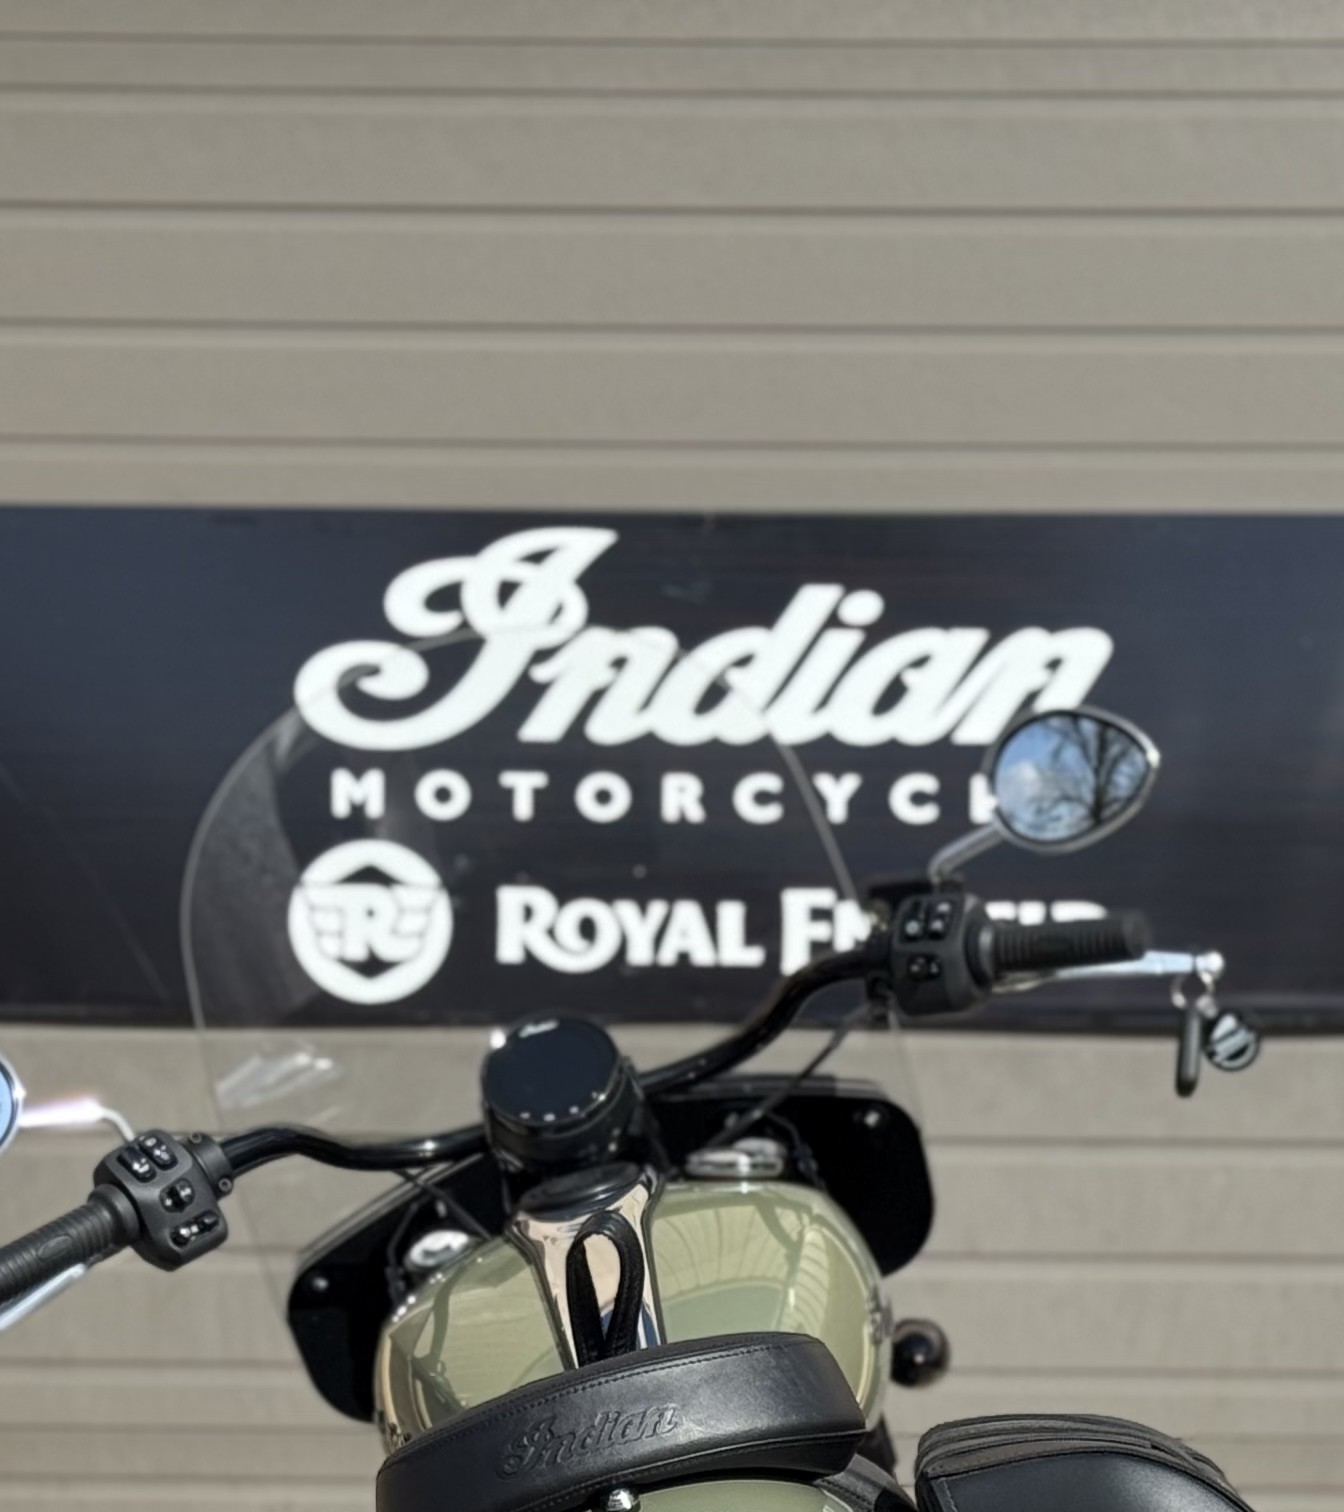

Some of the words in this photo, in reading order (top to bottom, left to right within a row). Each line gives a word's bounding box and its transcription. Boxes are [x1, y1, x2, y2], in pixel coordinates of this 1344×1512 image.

[293, 526, 1114, 751] Indian
[331, 767, 999, 824] MOTORCYCL
[496, 885, 765, 973] ROYAL
[495, 1403, 679, 1480] Indian
